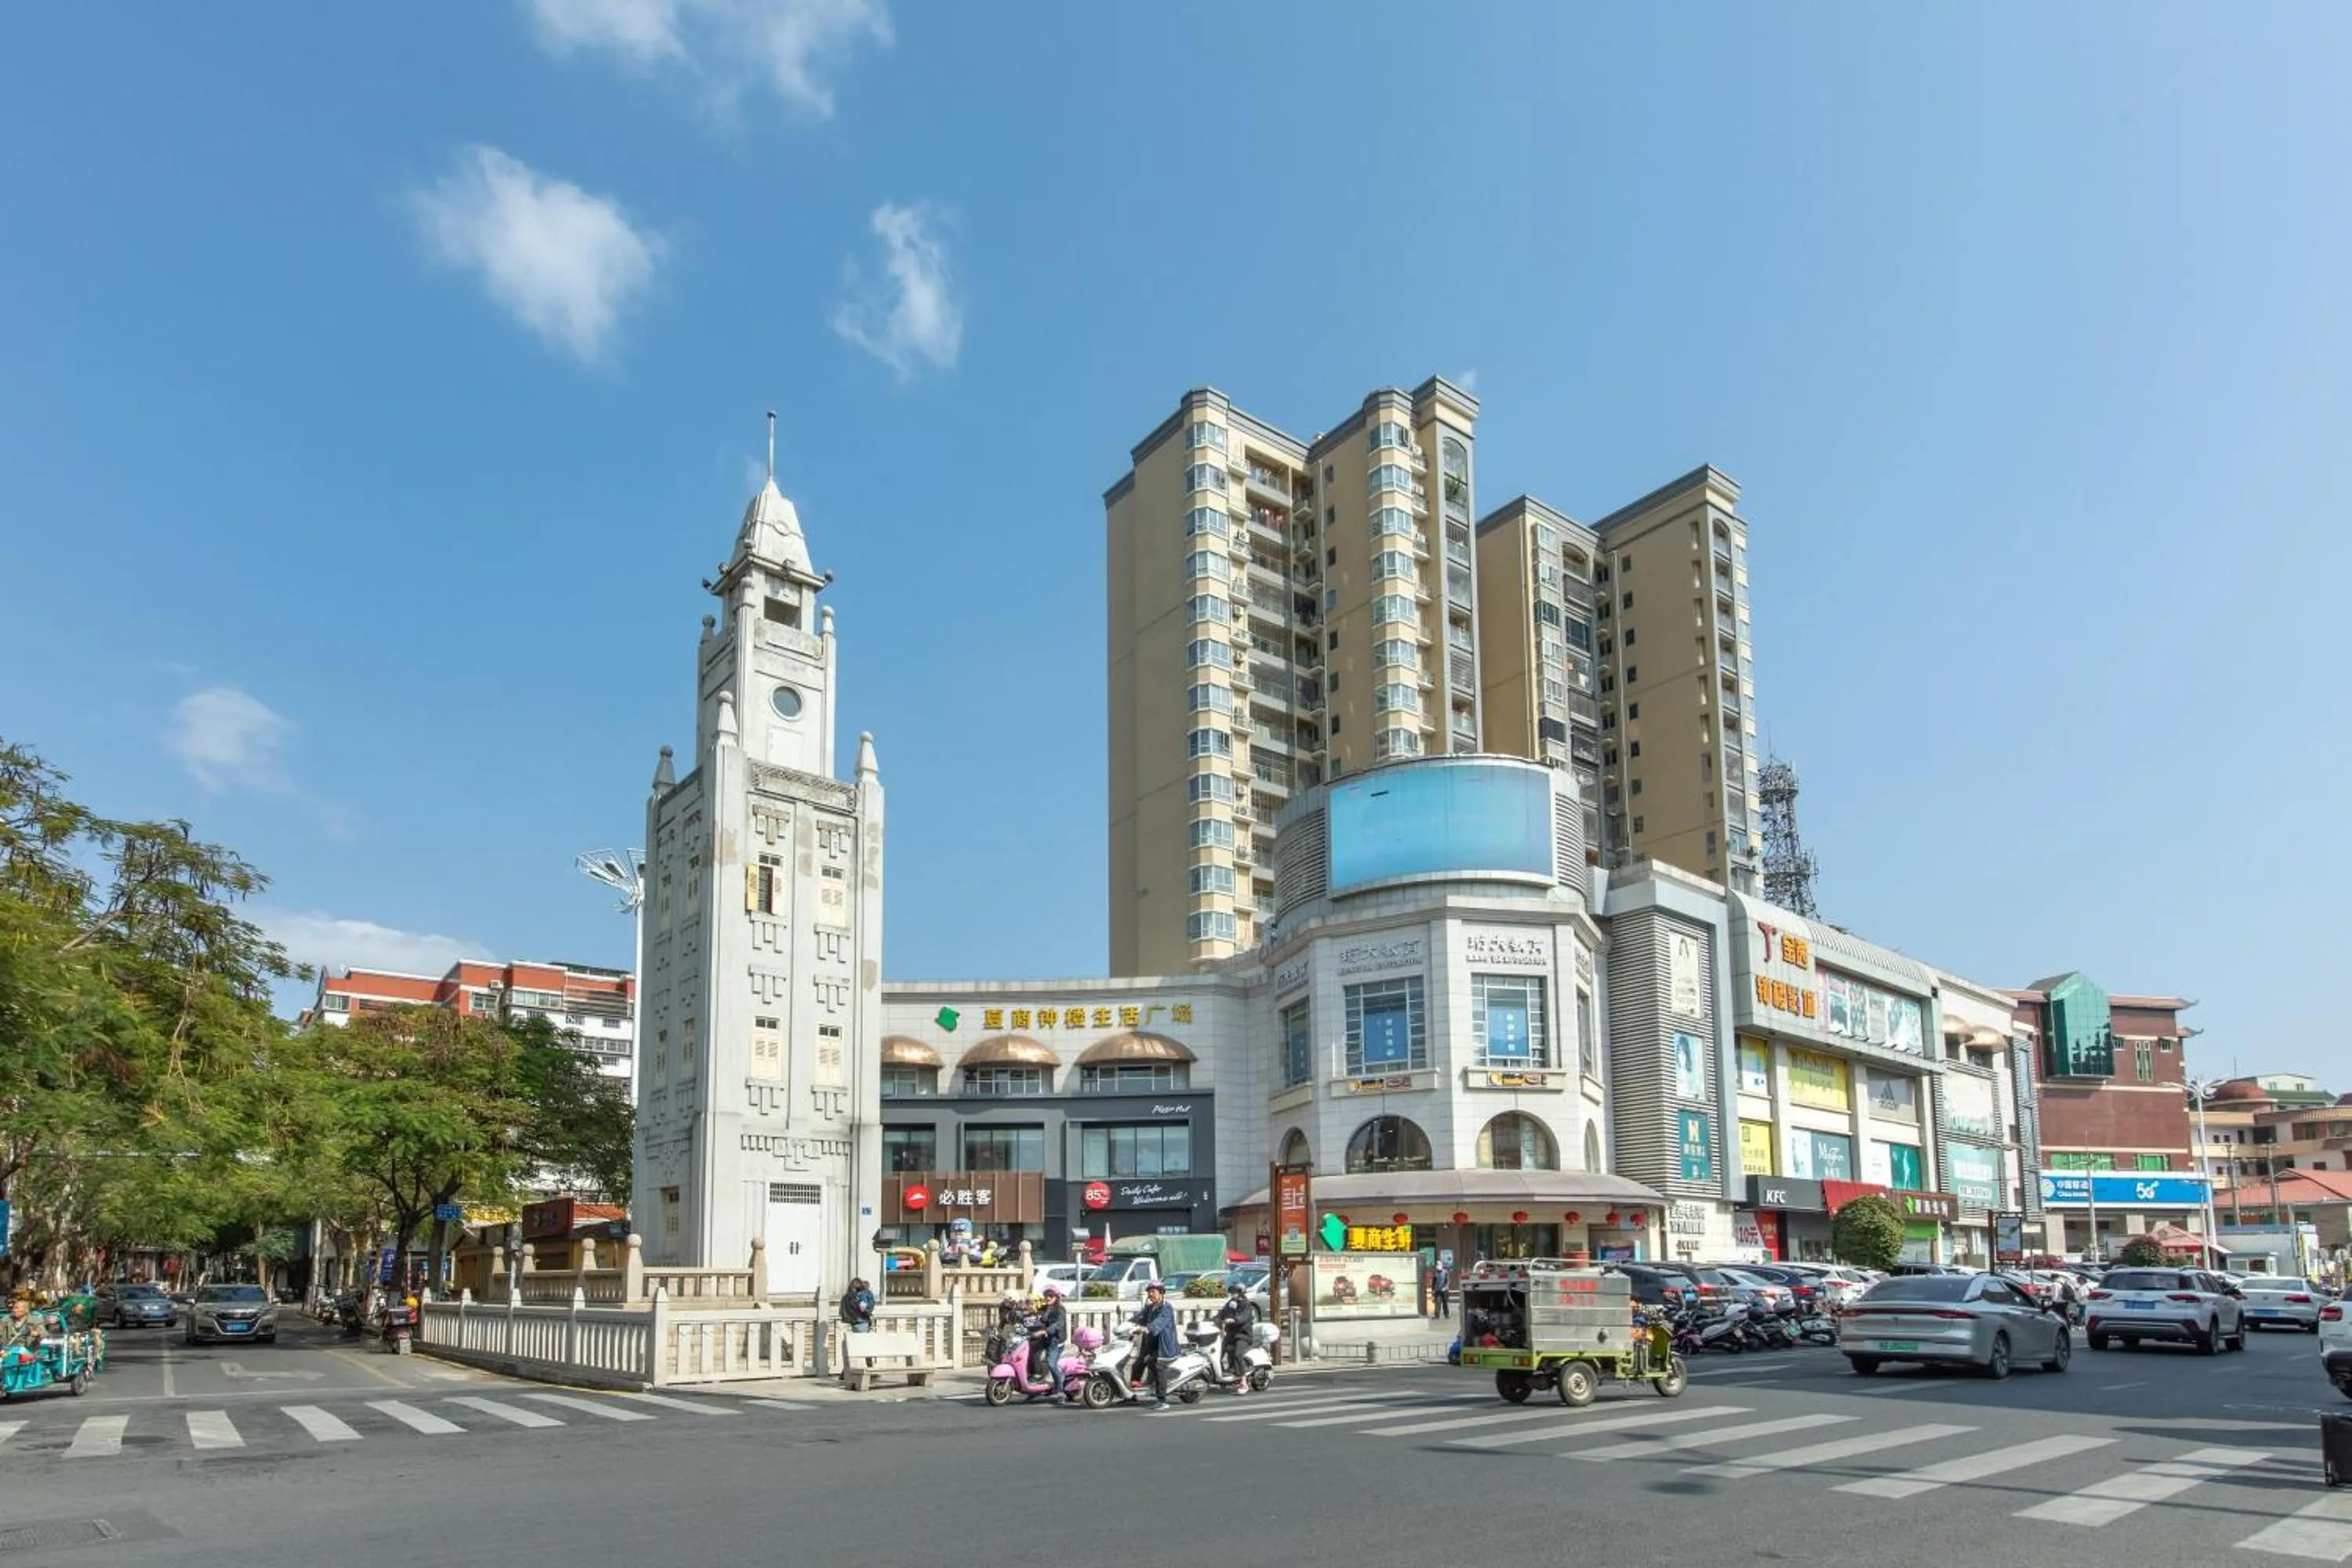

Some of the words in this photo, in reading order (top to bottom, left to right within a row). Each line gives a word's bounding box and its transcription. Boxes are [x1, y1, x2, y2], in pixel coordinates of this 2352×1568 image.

[983, 1003, 1193, 1030] 夏商钟楼生活广场
[938, 1189, 991, 1205] 必胜客
[1766, 1189, 1787, 1203] KFC
[1348, 1225, 1412, 1251] 夏商生鲜
